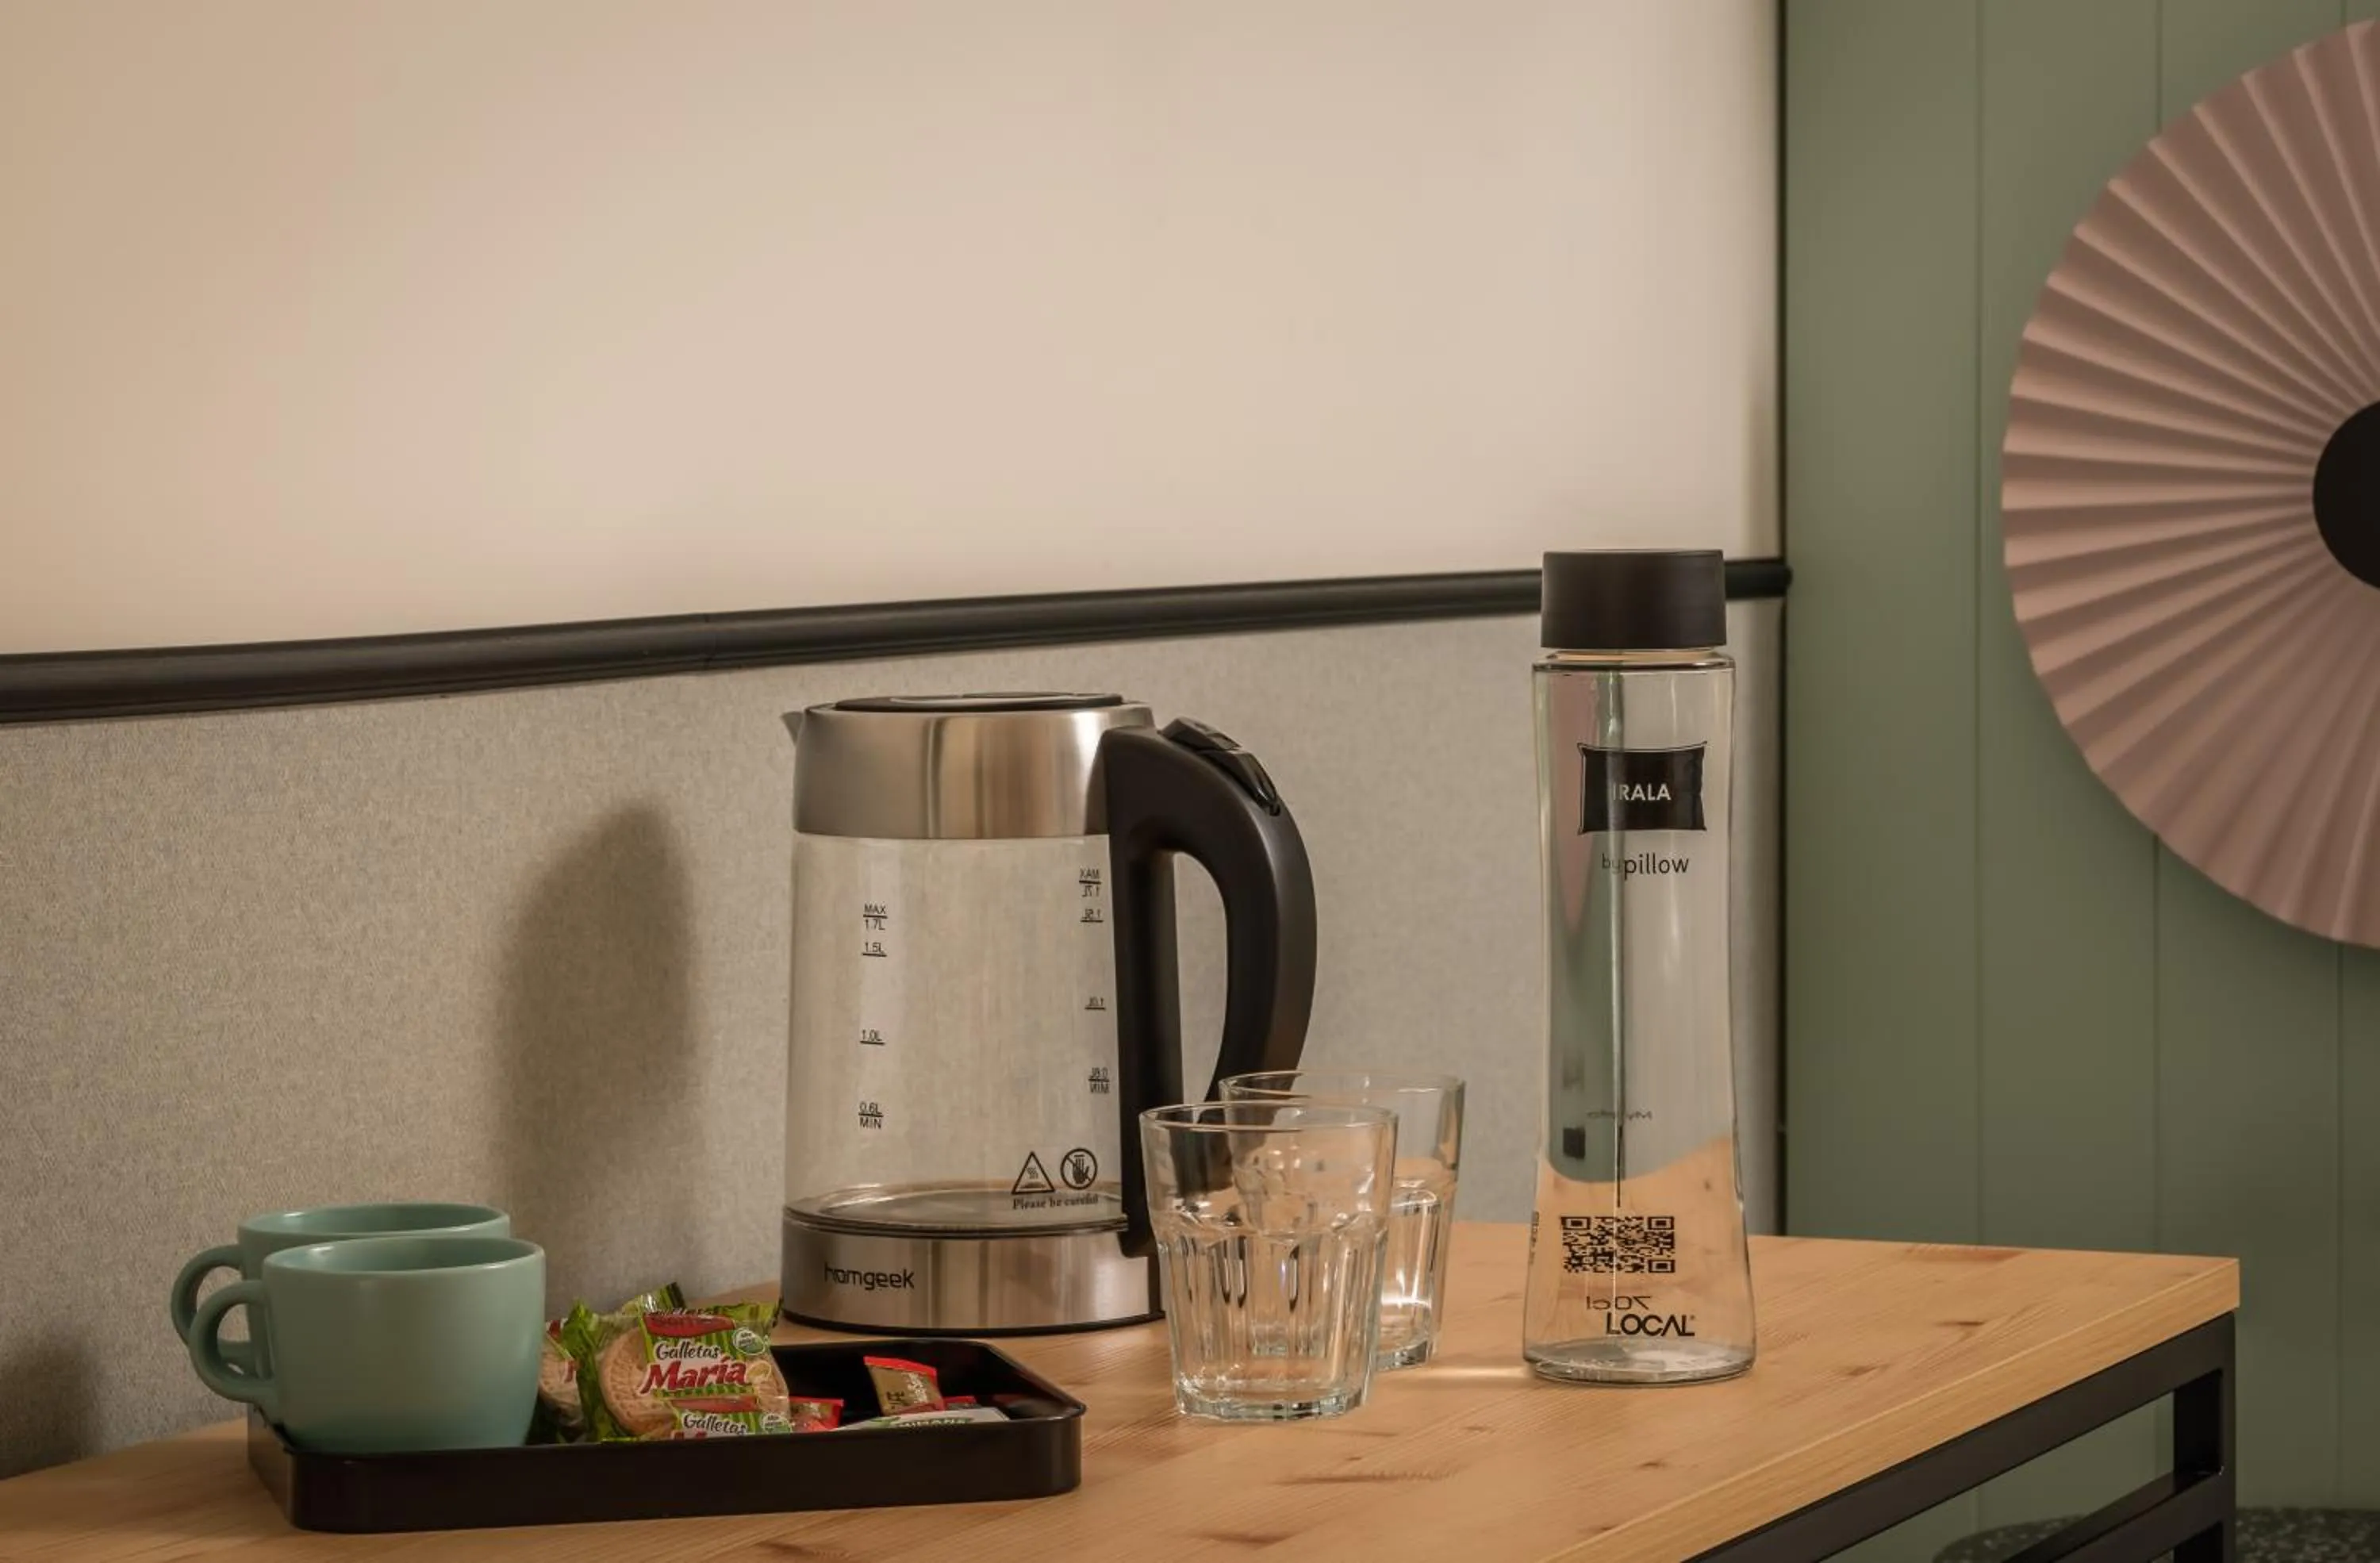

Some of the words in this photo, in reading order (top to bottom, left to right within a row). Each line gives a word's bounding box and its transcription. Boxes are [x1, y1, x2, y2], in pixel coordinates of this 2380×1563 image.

[1613, 782, 1672, 801] IRALA
[1624, 852, 1689, 881] pillow
[864, 903, 886, 915] MAX
[859, 1116, 882, 1130] MIN
[1013, 1198, 1046, 1210] Please
[1049, 1196, 1061, 1208] be
[824, 1262, 915, 1290] homgeek
[1606, 1312, 1695, 1337] LOCAL
[655, 1340, 721, 1360] Galletas
[639, 1354, 749, 1394] María
[683, 1412, 747, 1434] Galletas
